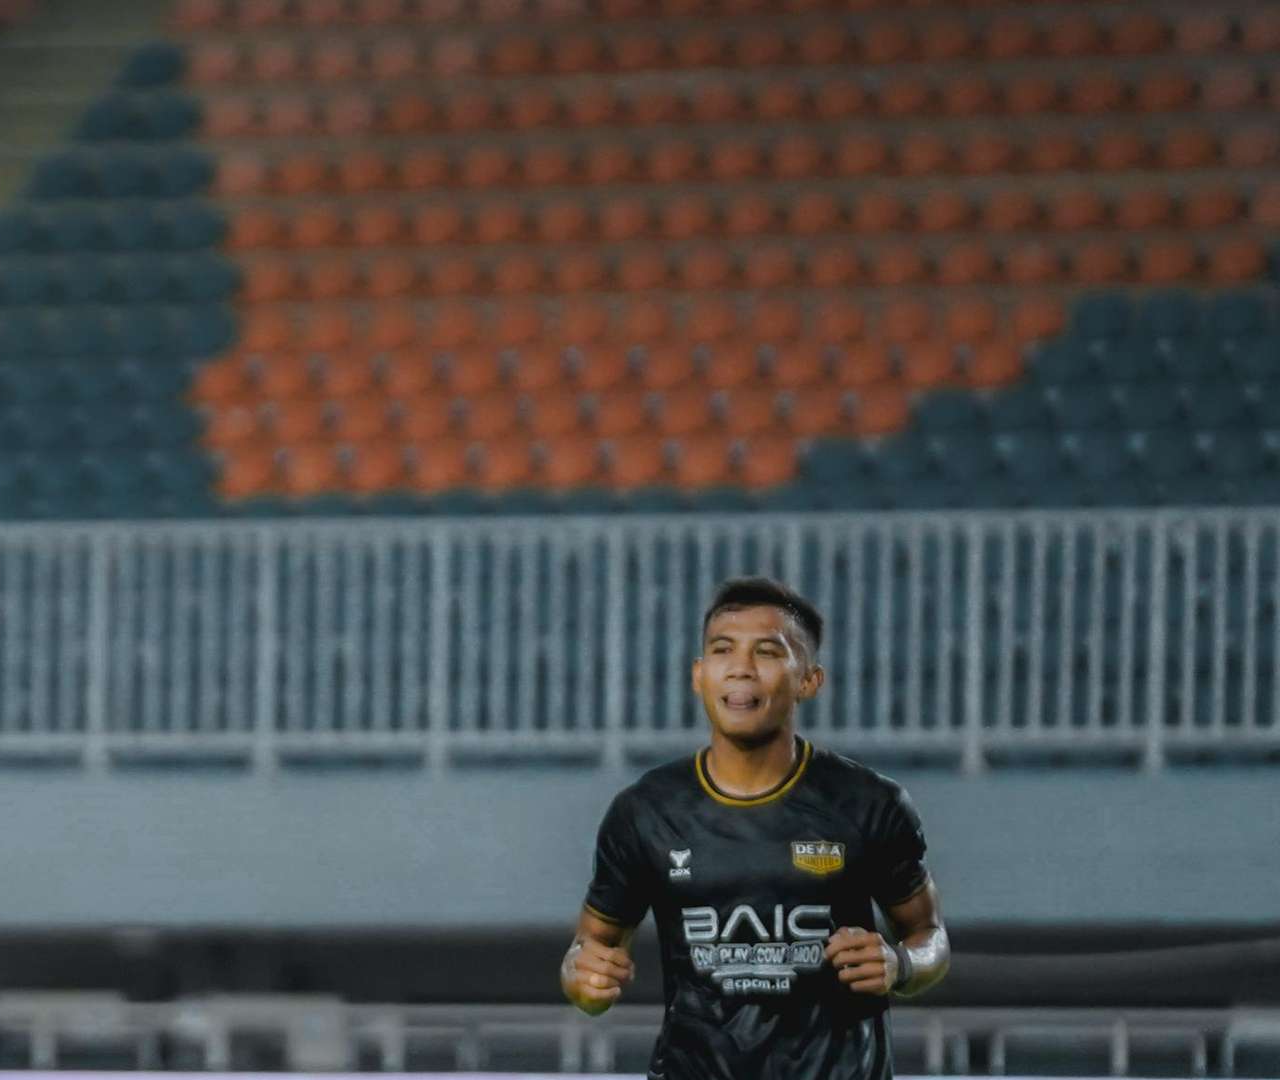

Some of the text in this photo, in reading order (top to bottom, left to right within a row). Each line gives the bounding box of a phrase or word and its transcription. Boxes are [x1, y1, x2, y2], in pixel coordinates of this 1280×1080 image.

[681, 903, 831, 942] BAIC
[757, 946, 786, 964] COW
[723, 977, 790, 992] @cpcm.id
